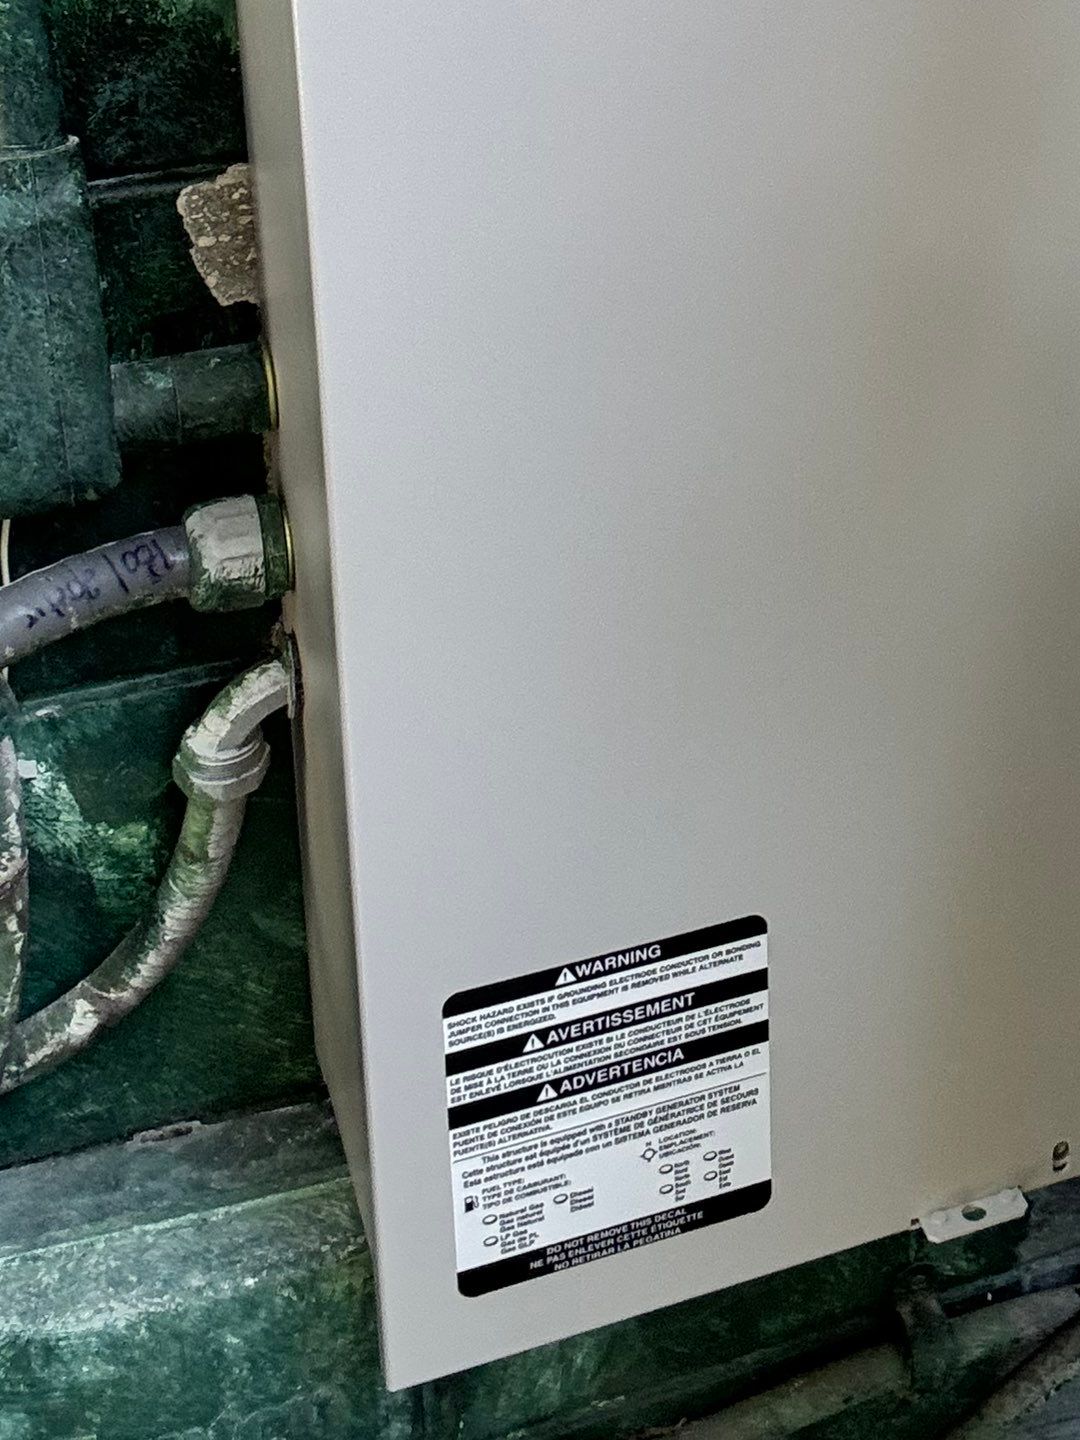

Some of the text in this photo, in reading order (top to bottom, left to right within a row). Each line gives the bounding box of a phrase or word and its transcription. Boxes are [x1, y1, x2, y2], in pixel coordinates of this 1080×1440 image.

[447, 1015, 477, 1029] SHOCK
[479, 1006, 514, 1021] HAZARD
[516, 997, 545, 1011] EXISTS
[556, 981, 607, 1000] GROUNDING
[608, 967, 657, 986] ELECTRODE
[659, 954, 709, 972] CONDUCTOR
[711, 950, 723, 959] OR
[725, 940, 761, 955] BONDING
[575, 944, 661, 979] WARNING
[447, 1023, 482, 1038] JUMPER
[484, 1008, 539, 1028] CONNECTION
[541, 1005, 550, 1013] IN
[551, 1000, 569, 1010] THIS
[571, 986, 619, 1005] EQUIPMENT
[630, 973, 670, 989] REMOVED
[671, 966, 696, 978] WHILE
[698, 953, 743, 971] ALTERNATE
[546, 991, 695, 1044] AVERTISSEMENT
[448, 1029, 495, 1047] SOURCE(S)
[496, 1026, 505, 1034] IS
[449, 1077, 460, 1086] LE
[462, 1068, 493, 1083] RISQUE
[575, 1038, 603, 1052] EXISTE
[615, 1032, 625, 1041] LE
[627, 1016, 683, 1037] CONDUCTEUR
[685, 1013, 696, 1022] DE
[450, 1086, 461, 1095] DE
[494, 1075, 505, 1083] LA
[506, 1066, 534, 1079] TERRE
[536, 1062, 548, 1071] OU
[550, 1058, 561, 1067] LA
[563, 1045, 612, 1064] CONNEXION
[613, 1041, 625, 1050] DU
[626, 1025, 682, 1046] CONNECTEUR
[683, 1021, 694, 1030] DE
[696, 1016, 712, 1027] CET
[450, 1093, 467, 1104] EST
[503, 1072, 543, 1089] LORSQUE
[613, 1038, 664, 1058] SECONDAIRE
[667, 1033, 682, 1043] EST
[684, 1027, 706, 1039] SOUS
[559, 1047, 684, 1093] ADVERTENCIA
[452, 1126, 480, 1140] EXISTE
[482, 1115, 518, 1131] PELIGRO
[520, 1112, 530, 1120] DE
[532, 1099, 577, 1117] DESCARGA
[591, 1081, 640, 1100] CONDUCTOR
[642, 1077, 653, 1086] DE
[654, 1062, 706, 1082] ELECTRODOS
[715, 1052, 742, 1065] TIERRA
[452, 1133, 485, 1148] PUENTE
[486, 1130, 498, 1139] DE
[543, 1114, 554, 1123] DE
[556, 1107, 577, 1119] ESTE
[578, 1098, 609, 1113] EQUIPO
[610, 1095, 620, 1104] SE
[622, 1087, 651, 1100] RETIRA
[652, 1075, 692, 1091] MIENTRAS
[693, 1071, 703, 1080] SE
[705, 1064, 732, 1076] ACTIVA
[733, 1060, 744, 1069] LA
[461, 1168, 483, 1179] Cette
[485, 1157, 522, 1172] structure
[524, 1151, 537, 1161] est
[633, 1120, 644, 1130] DE
[706, 1099, 717, 1109] DE
[720, 1088, 759, 1105] SECOURS
[481, 1154, 499, 1164] This
[501, 1143, 538, 1158] structure
[540, 1140, 547, 1148] is
[549, 1127, 587, 1145] equipped
[588, 1123, 606, 1133] with
[614, 1109, 653, 1126] STANDBY
[655, 1094, 706, 1116] GENERATOR
[707, 1084, 740, 1099] SYSTEM
[483, 1165, 525, 1183] estructura
[614, 1128, 651, 1145] SISTEMA
[652, 1112, 705, 1133] GENERADOR
[706, 1108, 718, 1118] DE
[719, 1097, 757, 1114] RESERVA
[482, 1191, 501, 1201] TYPE
[503, 1187, 514, 1195] DE
[482, 1199, 500, 1210] TIPO
[502, 1196, 512, 1204] DE
[498, 1202, 544, 1219] Natural Gas
[500, 1228, 527, 1241] LP Gas
[529, 1258, 543, 1269] NE
[546, 1252, 566, 1264] PAS
[567, 1238, 614, 1257] ENLEVER
[616, 1227, 647, 1243] CETTE
[546, 1208, 686, 1255] DO NOT REMOVE THIS DECAL
[554, 1226, 682, 1270] NO RETIRAR LA PEGATINA
